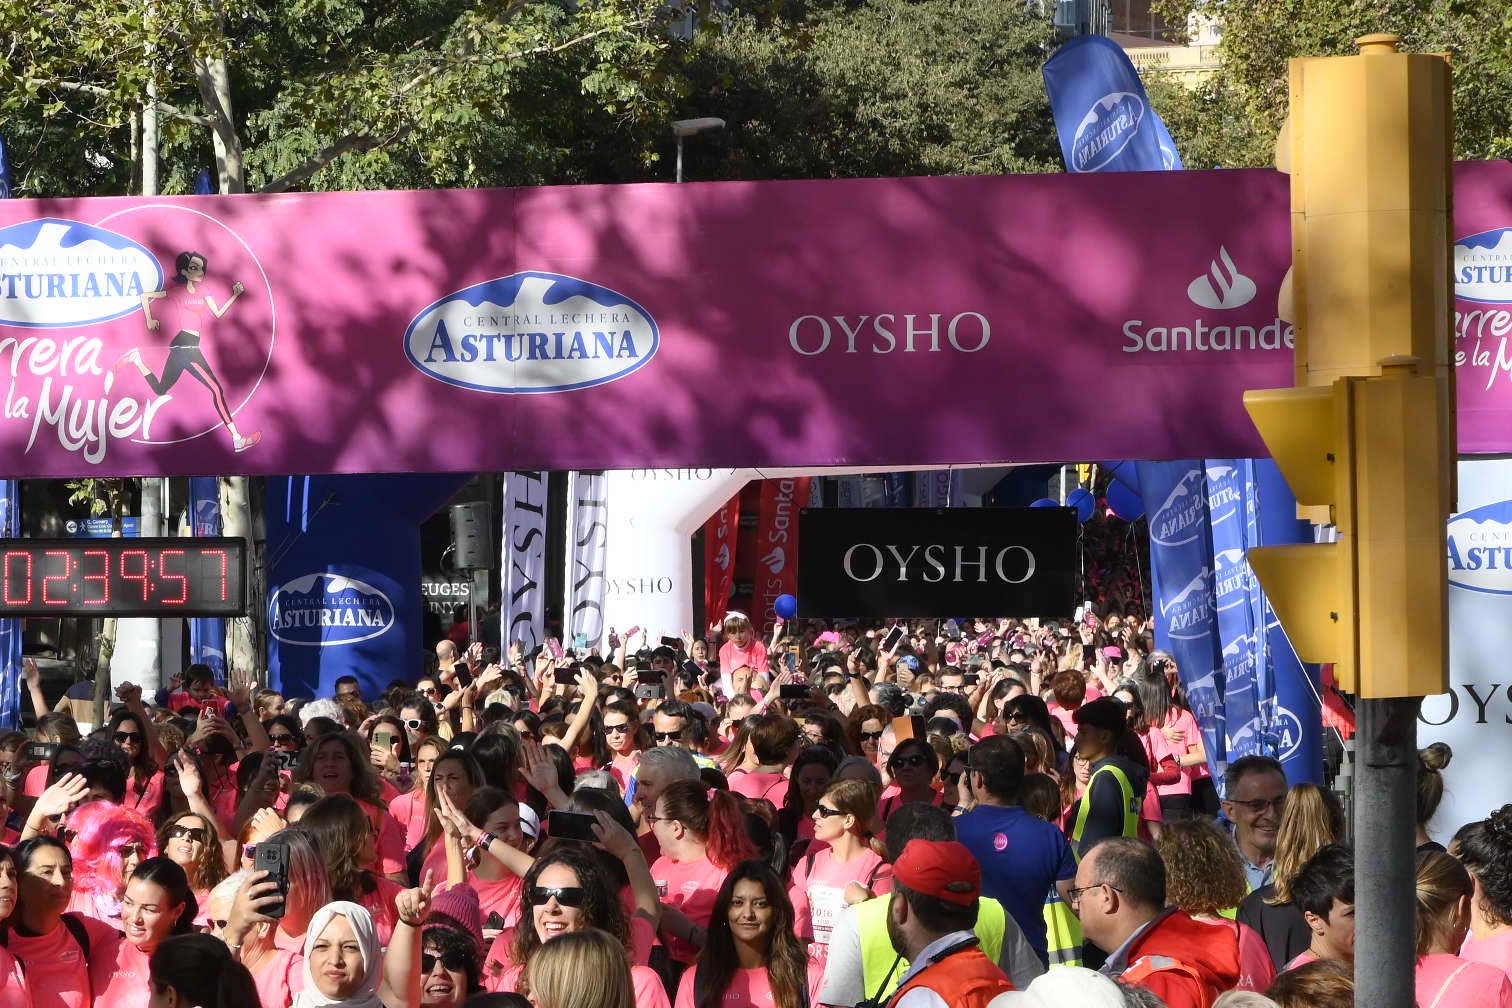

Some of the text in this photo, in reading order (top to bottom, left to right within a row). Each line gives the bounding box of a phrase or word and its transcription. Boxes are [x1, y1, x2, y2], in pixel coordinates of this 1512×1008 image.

[425, 318, 639, 363] ASTURIANA
[464, 312, 631, 327] CENTRAL LECHERA
[788, 310, 992, 357] OYSHO
[1121, 319, 1295, 353] Santande
[4, 380, 30, 420] la
[25, 372, 174, 465] Mujer
[769, 479, 795, 544] Santa
[3, 549, 227, 606] 02:39:57
[843, 543, 1037, 584] OYSHO
[602, 576, 673, 595] OYSHO
[272, 601, 386, 630] ASTURIANA
